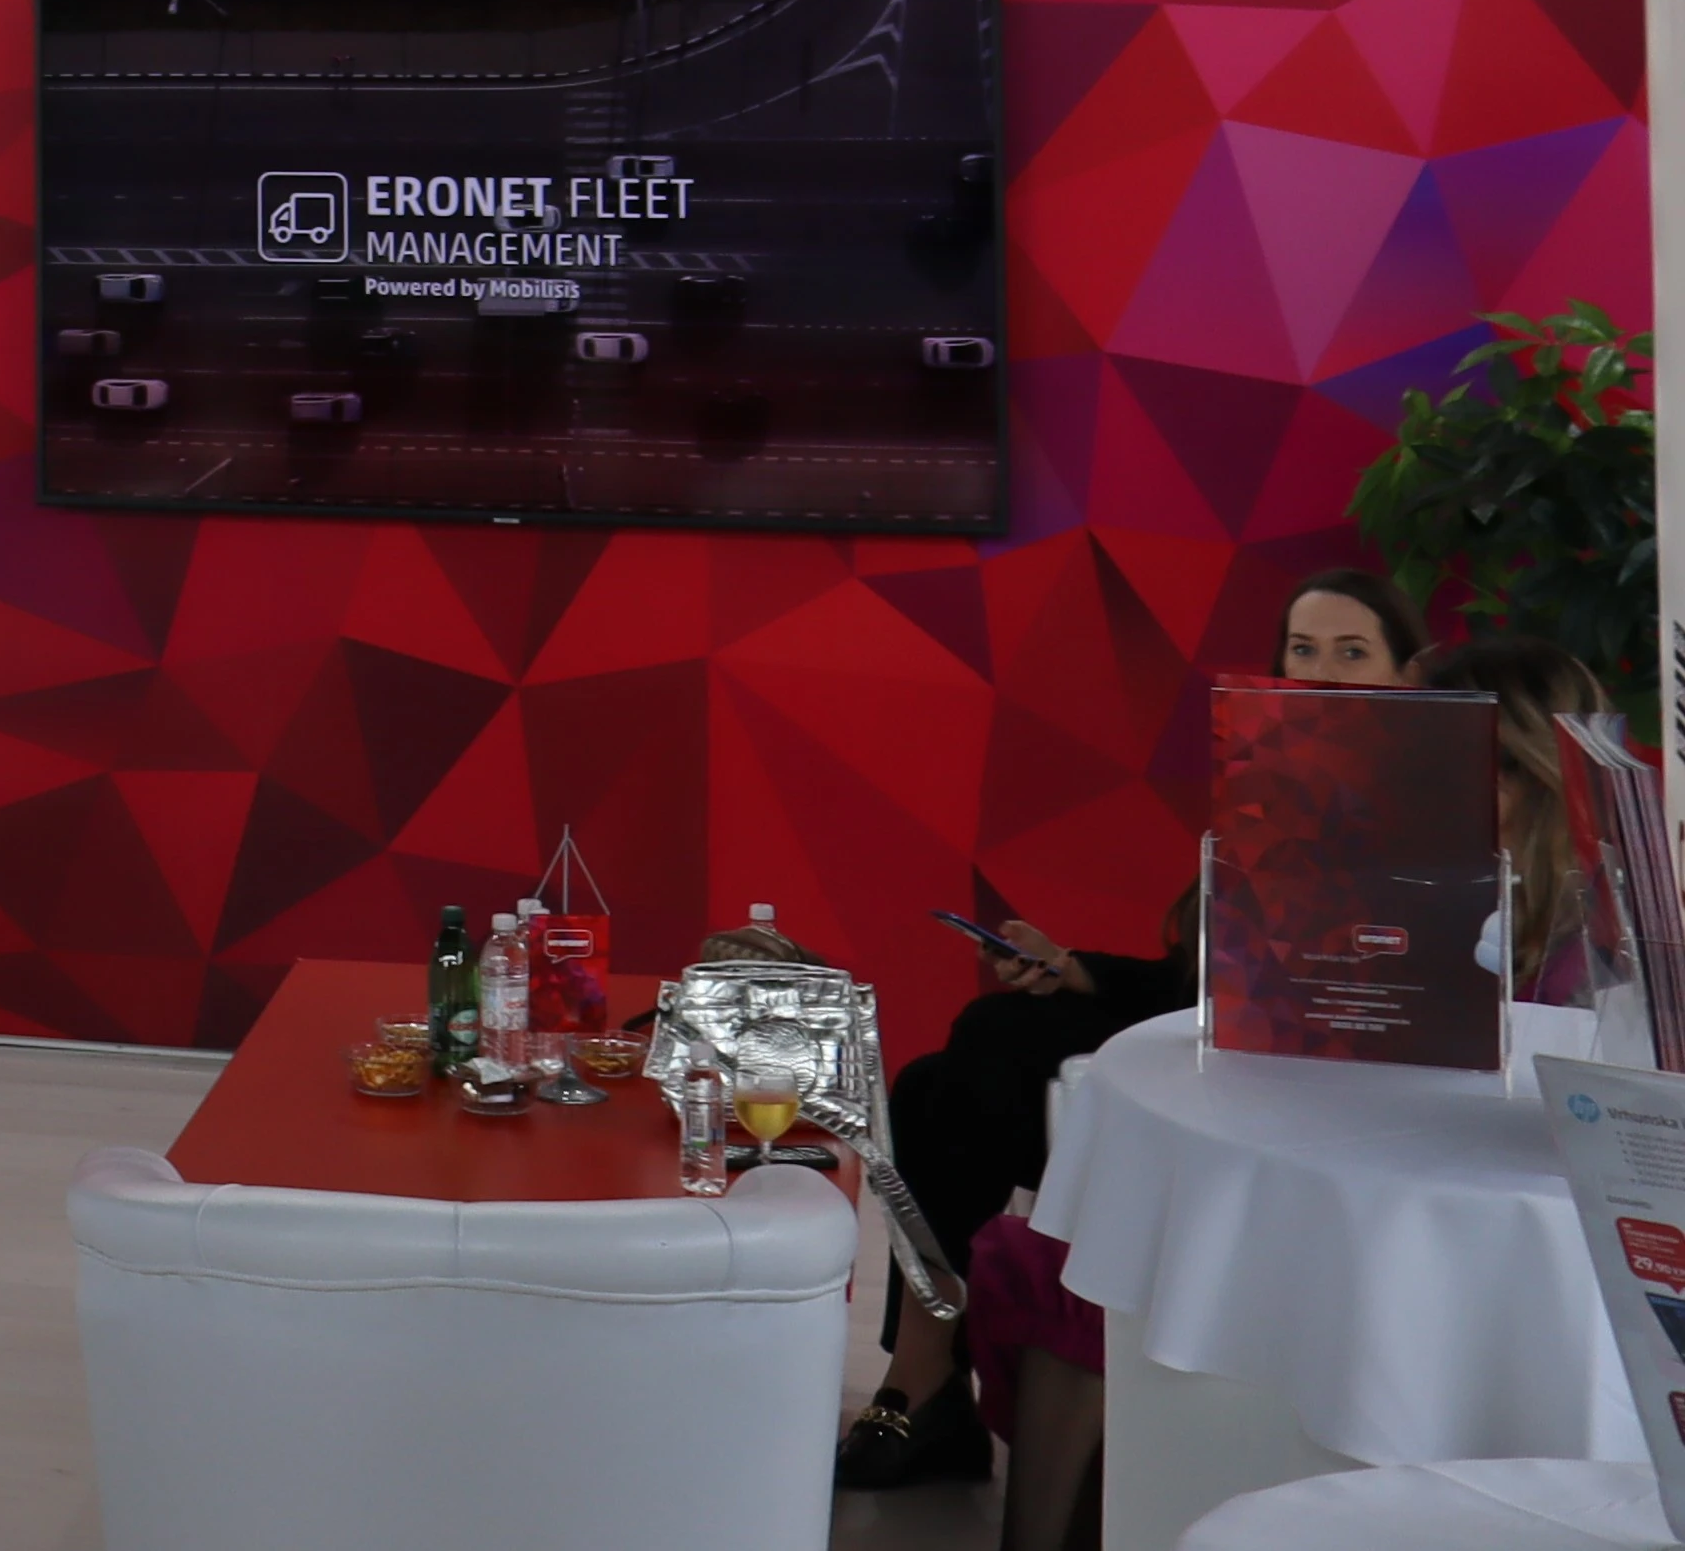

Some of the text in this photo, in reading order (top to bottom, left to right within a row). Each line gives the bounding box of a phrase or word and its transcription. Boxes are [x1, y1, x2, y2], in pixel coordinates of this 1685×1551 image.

[366, 175, 694, 219] ERONET FLEET
[367, 231, 623, 267] MANAGEMENT
[364, 275, 580, 300] Powered by Mobilisis
